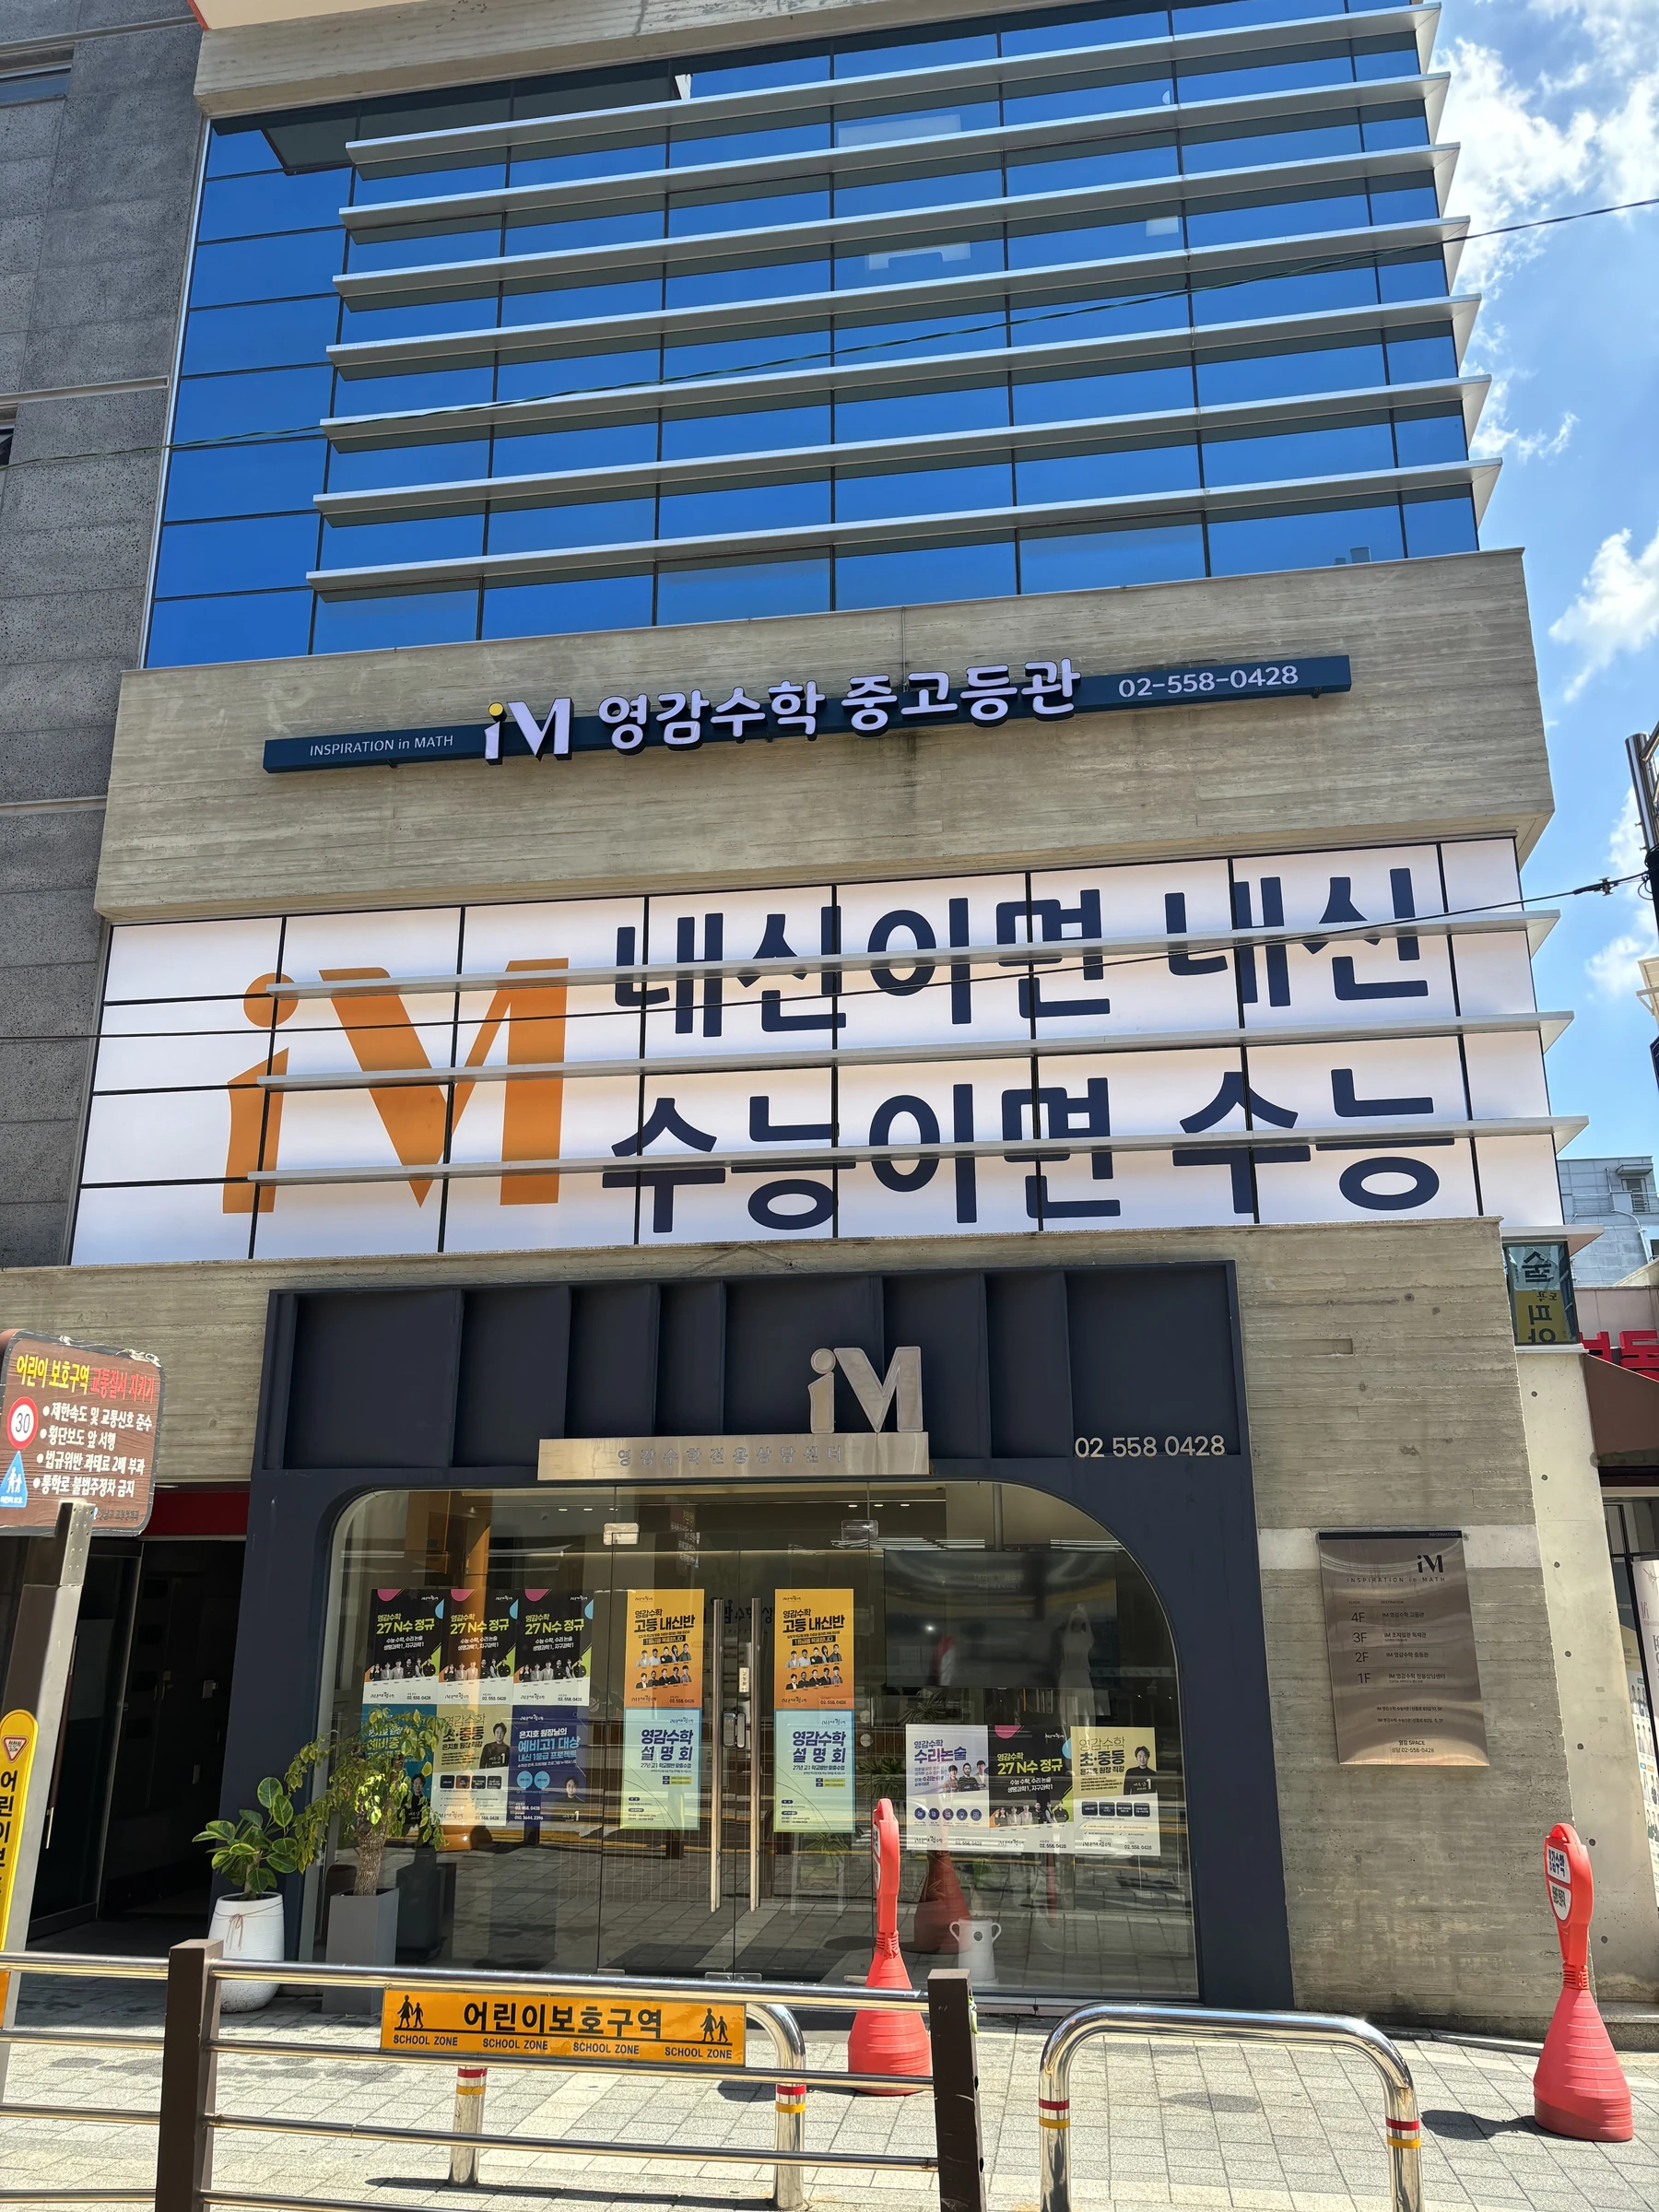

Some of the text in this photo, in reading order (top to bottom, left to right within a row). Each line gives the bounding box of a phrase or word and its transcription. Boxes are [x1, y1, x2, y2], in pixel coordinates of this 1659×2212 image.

[1118, 665, 1299, 698] 02-558-0428
[598, 658, 1081, 754] 영감수학 중고등관
[484, 698, 573, 765] iM
[310, 735, 453, 757] INSPIRATION in MATH
[615, 867, 1429, 1037] 내신이면 내신
[602, 1068, 1455, 1233] 수능이면 수능
[16, 1354, 155, 1404] 어린이 보호구역 교통질서 지키기
[807, 1346, 923, 1434] iM
[16, 1413, 30, 1433] 30
[51, 1402, 152, 1431] 제한속도 및 교통신호 준수
[48, 1425, 116, 1452] 횡단보도 앞 서행
[1075, 1435, 1225, 1458] 02 558 0428
[46, 1450, 146, 1476] 법규위반 과태료 2배 부과
[41, 1475, 135, 1498] 통학로 불법주정차 금지
[1418, 1555, 1443, 1573] iM
[378, 1613, 401, 1622] 영감수학
[451, 1613, 475, 1622] 영감수학
[525, 1613, 549, 1622] 영감수학
[635, 1608, 663, 1618] 영감수학
[783, 1608, 811, 1618] 영감수학
[1351, 1612, 1365, 1622] 4F
[376, 1618, 434, 1634] 27 N수 정규
[451, 1618, 509, 1634] 27 N수 정규
[525, 1618, 584, 1635] 27 N수 정규
[634, 1615, 695, 1632] 고등 내신반
[782, 1615, 845, 1633] 고등 내신반
[1353, 1632, 1367, 1642] 3F
[1355, 1652, 1369, 1662] 2F
[1358, 1673, 1371, 1683] 1F
[445, 1713, 485, 1727] 영감수학
[519, 1728, 567, 1739] 은지호 원장님의
[641, 1729, 693, 1745] 영감수학
[793, 1731, 846, 1747] 영감수학
[518, 1736, 581, 1752] 예비고1 대상
[914, 1739, 943, 1748] 영감수학
[1079, 1736, 1124, 1751] 영감수학
[534, 1752, 548, 1760] 1등급
[550, 1750, 577, 1759] 프로젝트
[914, 1747, 967, 1764] 수리논술
[997, 1752, 1023, 1761] 영감수학
[998, 1759, 1063, 1775] 27 N수 정규
[464, 2001, 662, 2039] 어린이보호구역
[394, 2034, 732, 2060] SCHOOL ZONE SCHOOL ZONE SCHOOL ZONE SCHOOL ZONE
